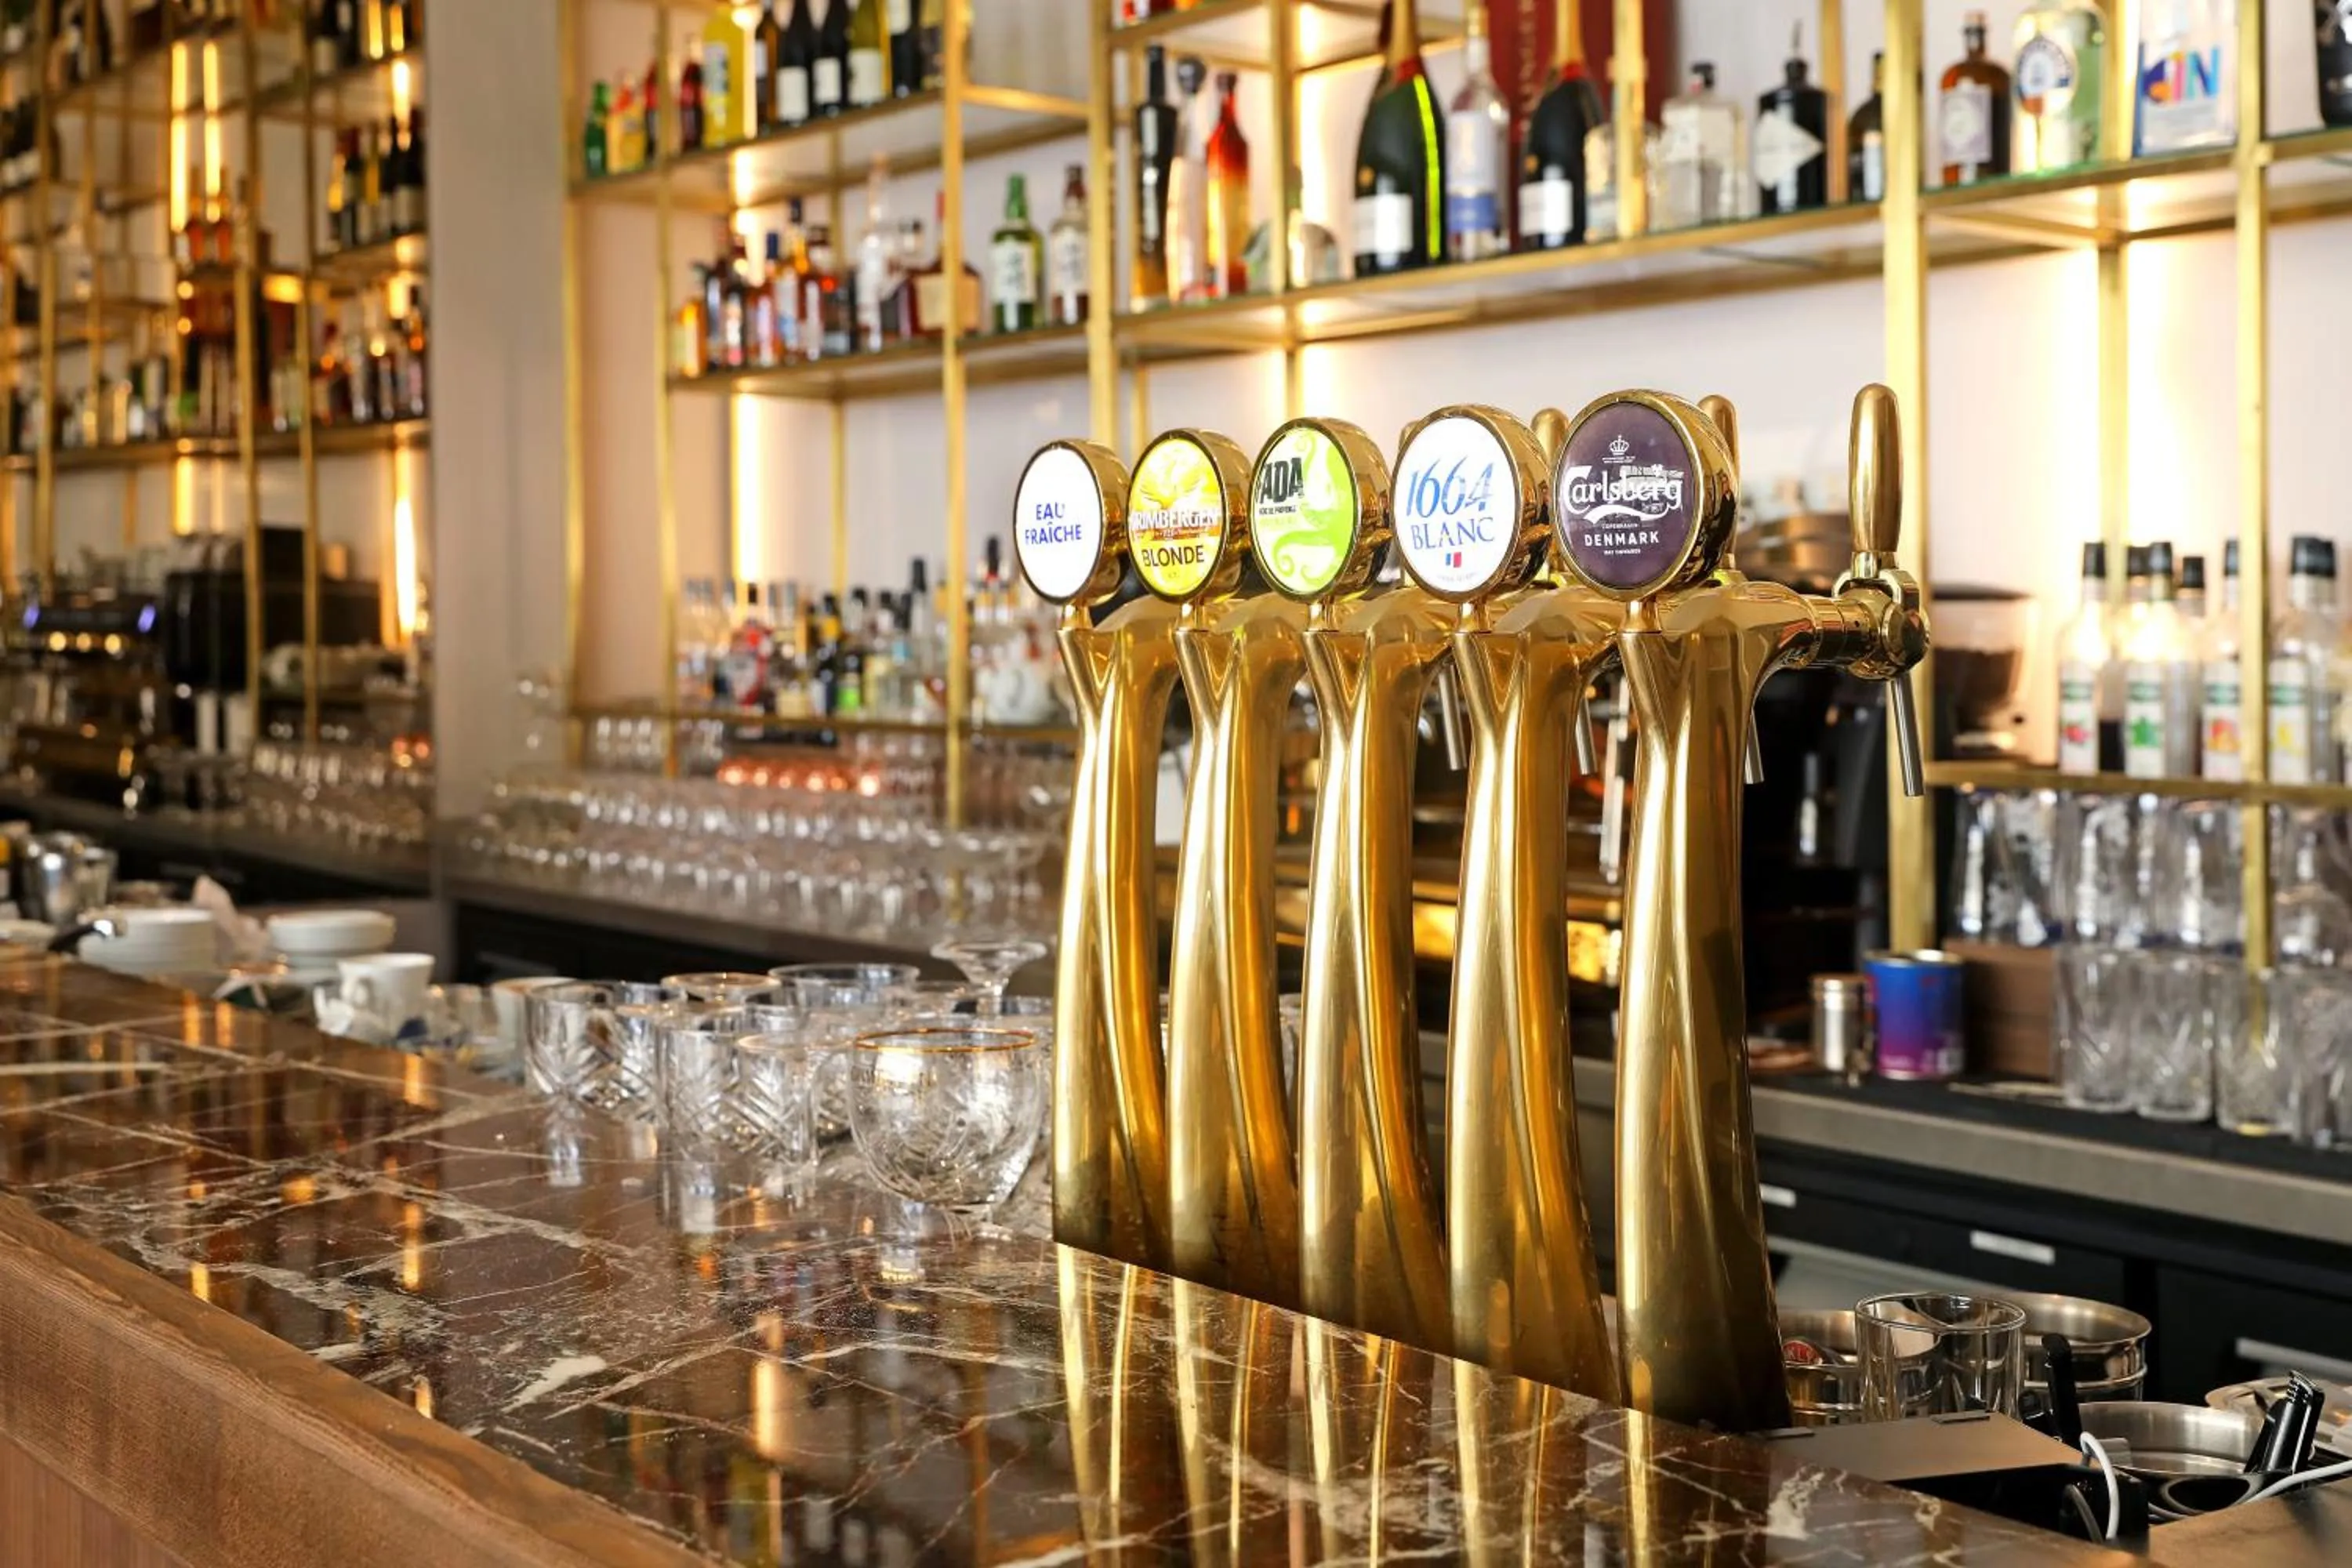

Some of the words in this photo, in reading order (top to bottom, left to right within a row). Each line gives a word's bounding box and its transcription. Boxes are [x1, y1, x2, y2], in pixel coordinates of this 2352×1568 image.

[1254, 457, 1303, 504] ADA
[1406, 455, 1494, 518] 1664
[1563, 465, 1683, 514] Carlsberg
[1036, 502, 1065, 520] EAU
[1025, 521, 1082, 545] FRAÎCHE
[1411, 517, 1494, 550] BLANC
[1584, 531, 1660, 546] DENMARK
[1141, 545, 1205, 567] BLONDE
